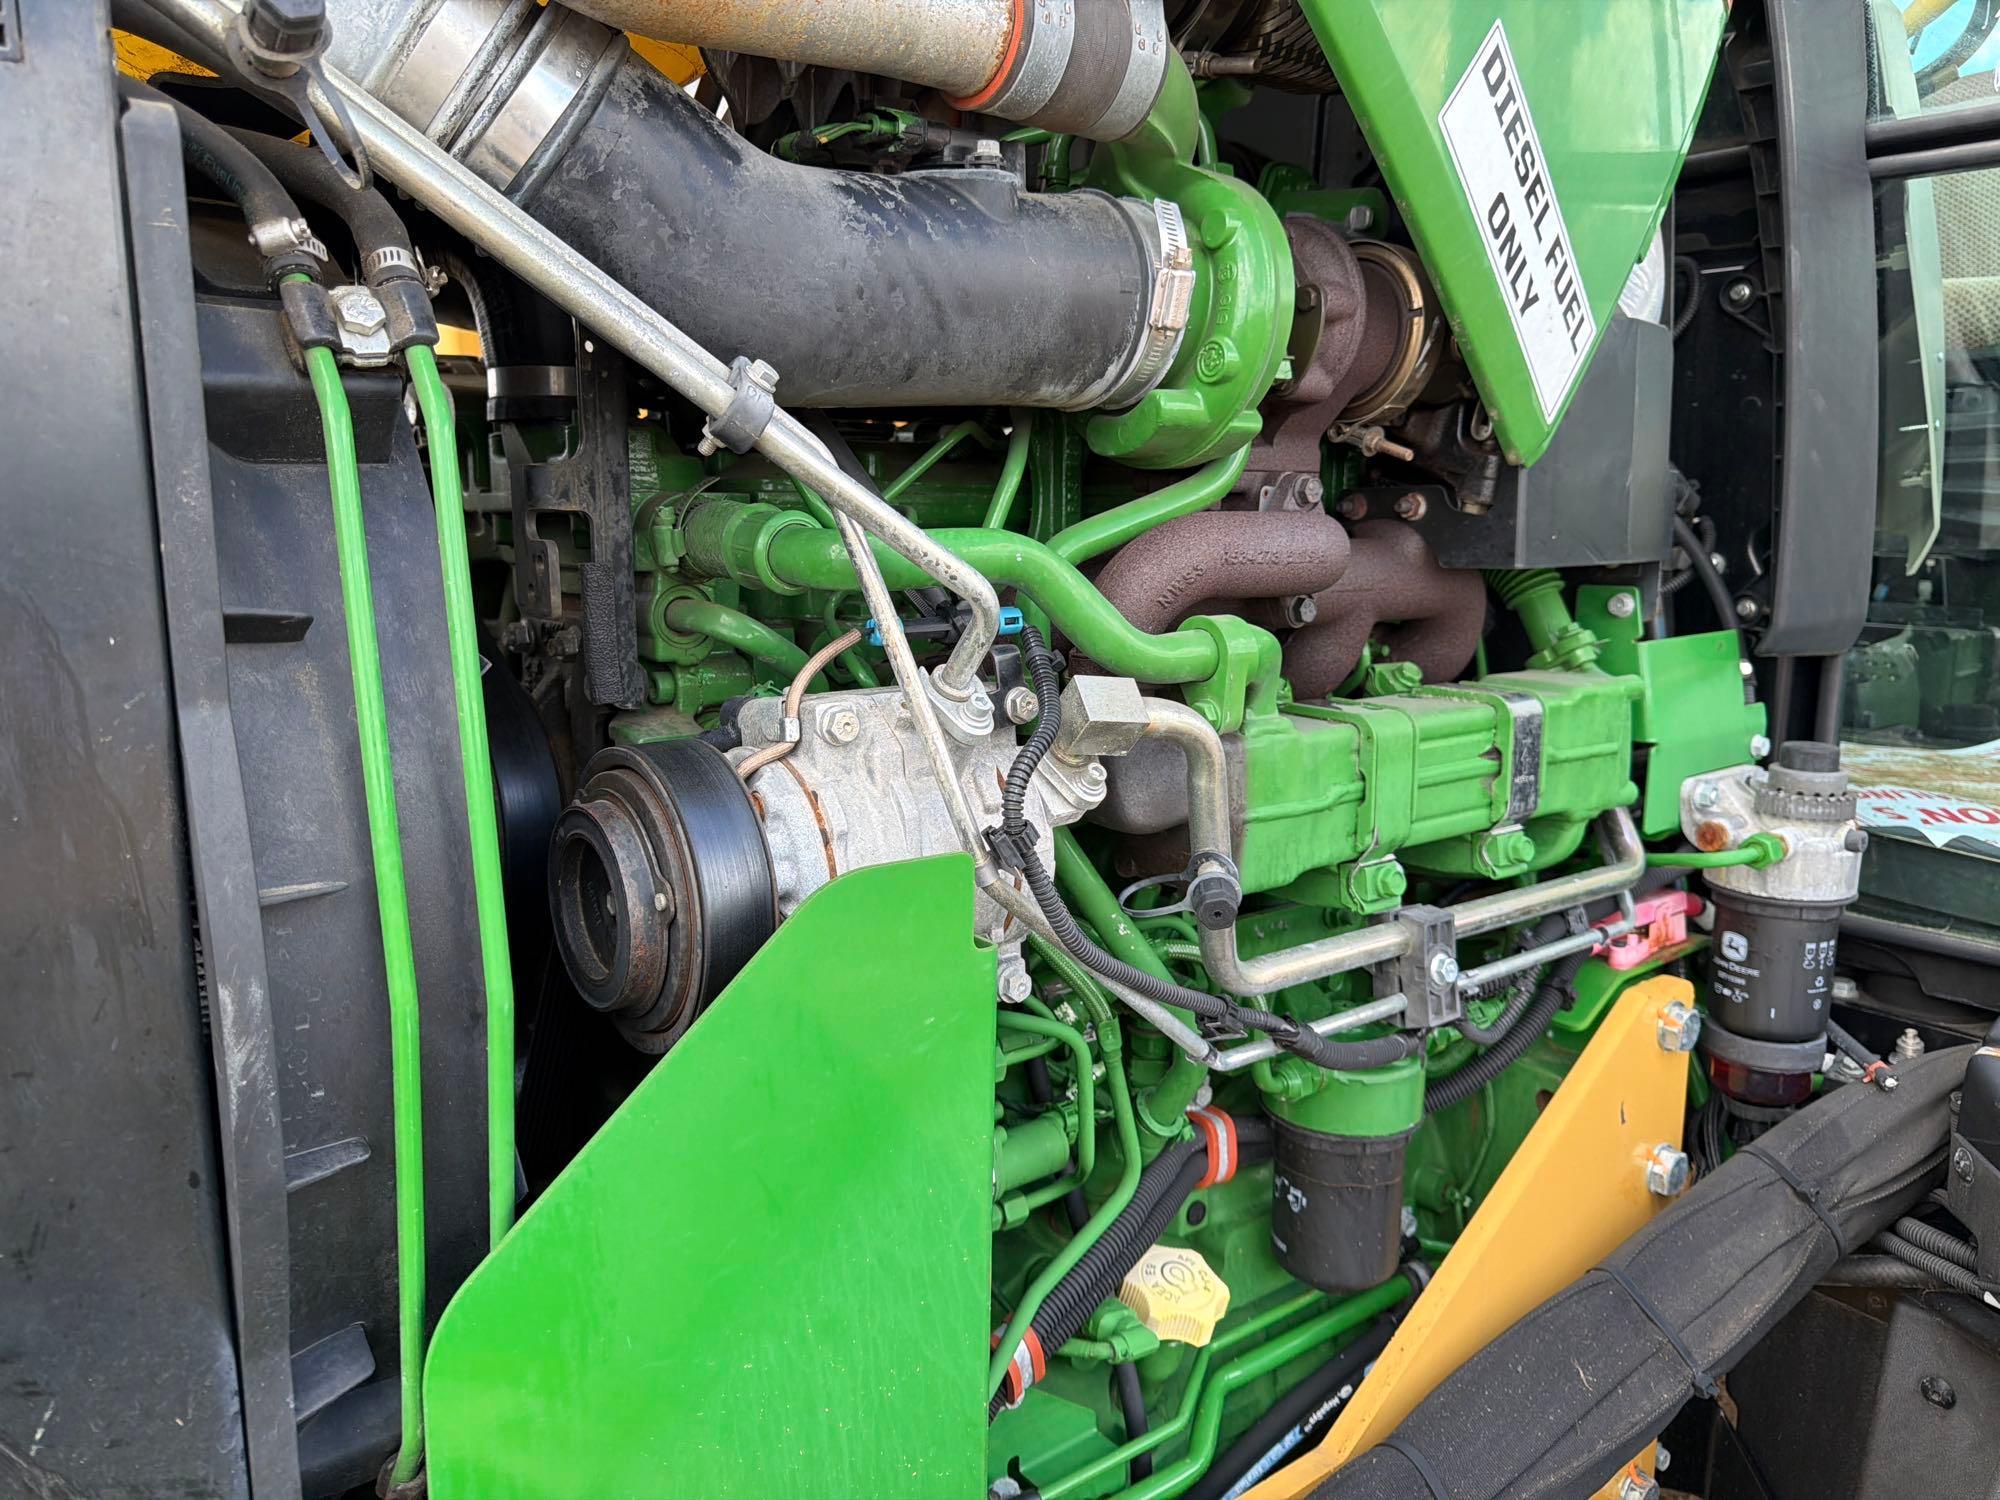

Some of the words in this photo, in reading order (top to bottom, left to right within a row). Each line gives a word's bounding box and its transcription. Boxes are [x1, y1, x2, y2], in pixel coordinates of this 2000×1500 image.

[1482, 44, 1550, 244] DIESEL
[1545, 232, 1586, 356] FUEL
[1487, 191, 1540, 318] ONLY
